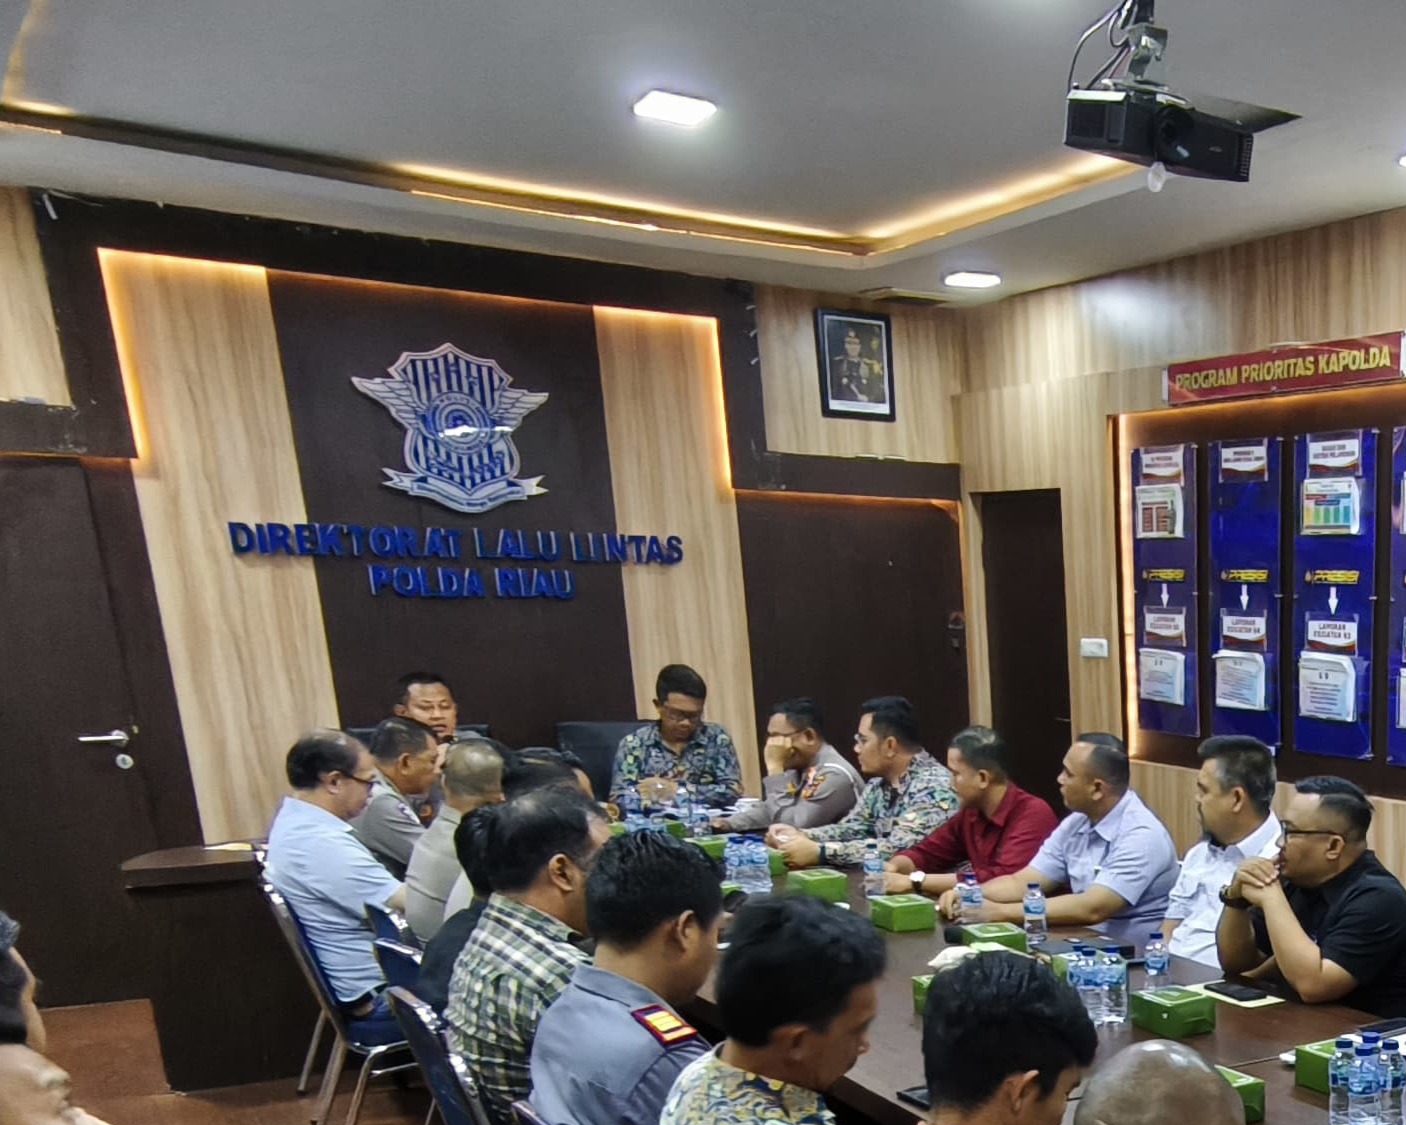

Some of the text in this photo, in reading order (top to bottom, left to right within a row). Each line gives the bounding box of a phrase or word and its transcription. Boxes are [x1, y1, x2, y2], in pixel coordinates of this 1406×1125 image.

[1175, 345, 1392, 390] PROGRAM PRIORITAS KAPOLDA
[228, 522, 684, 566] DIREKTORAT LALU LINTAS
[368, 564, 576, 600] POLDA RIAU
